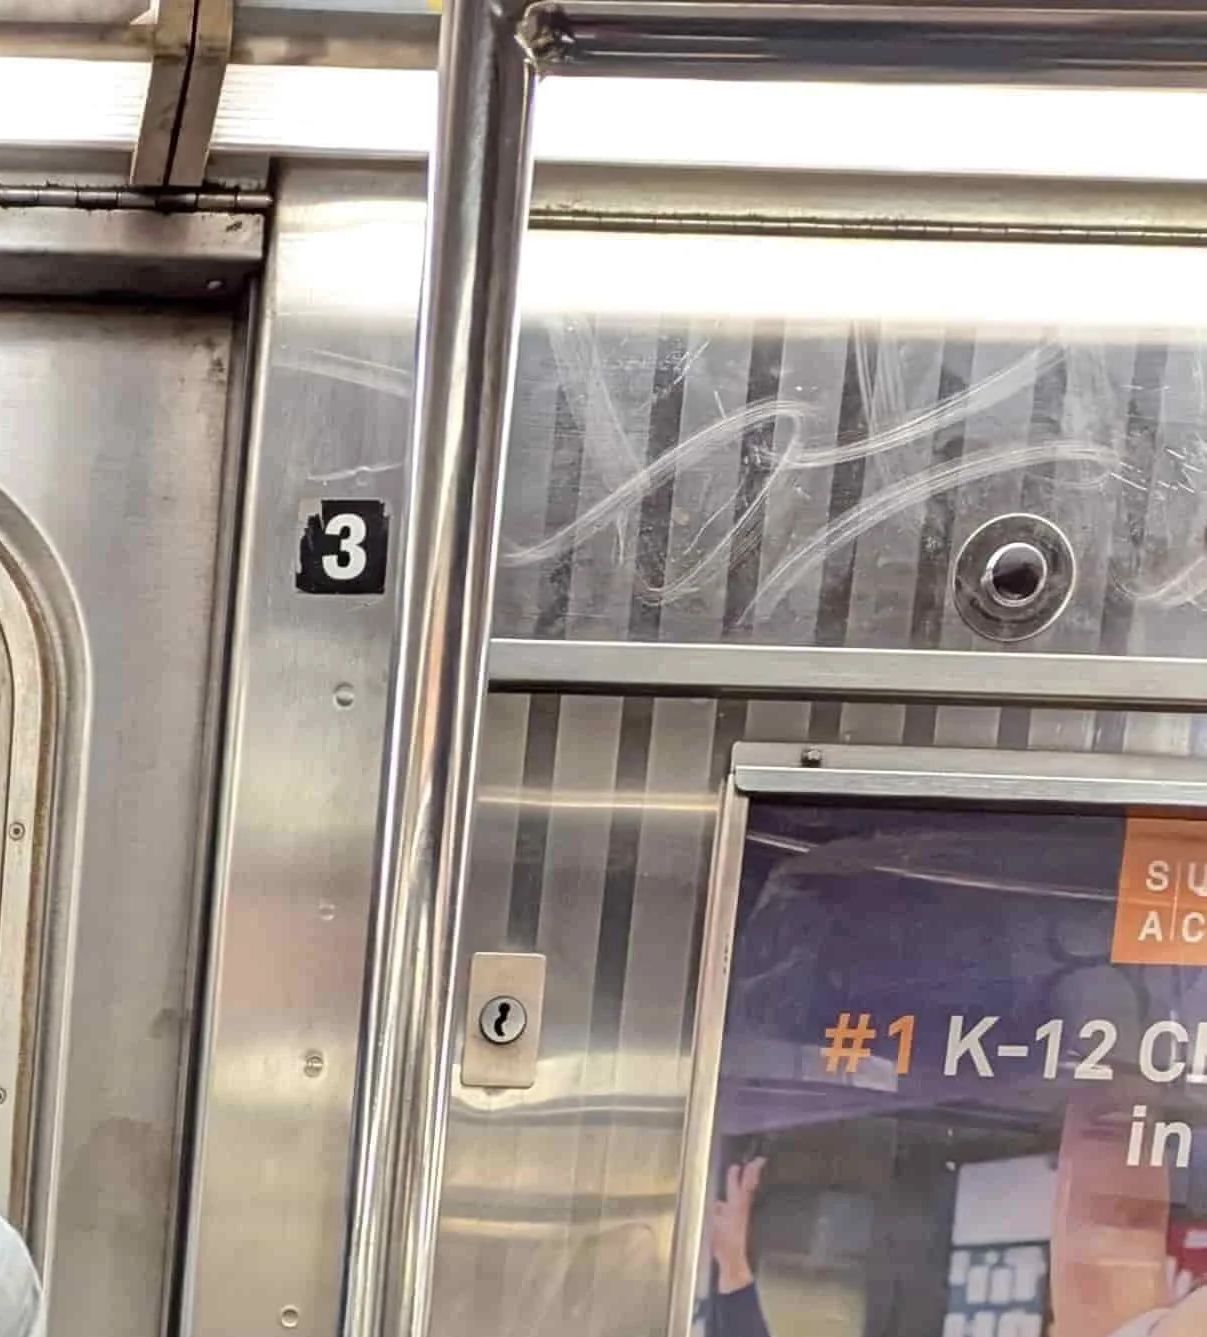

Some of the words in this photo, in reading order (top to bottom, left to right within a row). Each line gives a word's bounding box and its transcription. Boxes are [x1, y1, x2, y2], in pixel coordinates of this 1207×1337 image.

[321, 513, 368, 581] 3
[820, 1012, 915, 1075] #1
[943, 1015, 1118, 1081] K-12
[1126, 1104, 1193, 1169] in
